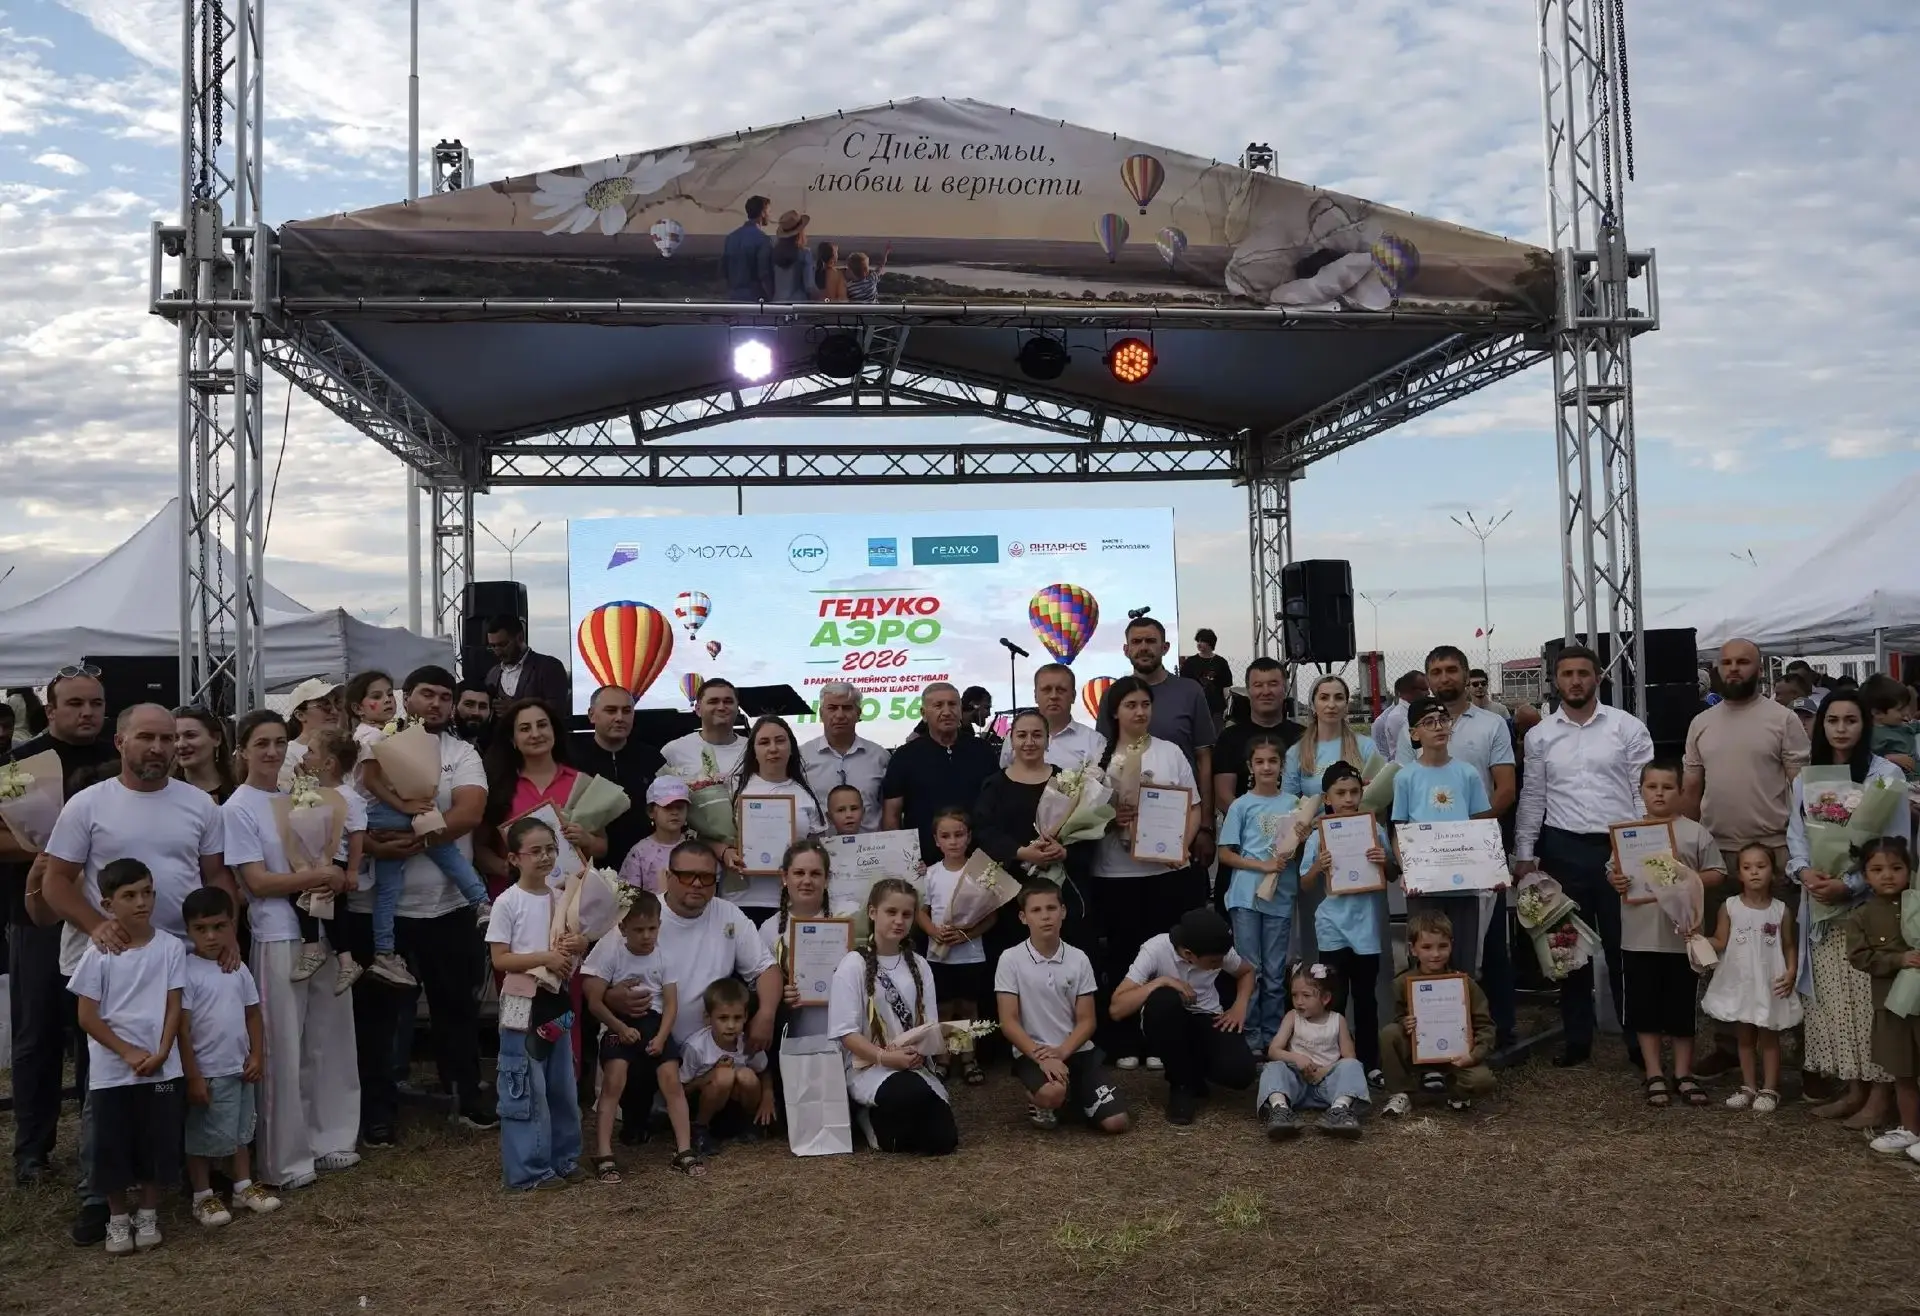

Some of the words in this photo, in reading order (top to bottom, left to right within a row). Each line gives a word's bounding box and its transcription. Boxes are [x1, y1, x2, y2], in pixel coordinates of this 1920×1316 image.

[843, 132, 865, 159] С
[868, 132, 951, 165] Днём
[961, 142, 1055, 166] семьи,
[808, 166, 903, 192] любви
[914, 175, 931, 193] и
[941, 175, 1083, 201] верности
[792, 548, 824, 559] КБР
[931, 545, 979, 555] ГЕДУКО
[1029, 542, 1087, 552] ЯНТАРНОЕ
[818, 596, 940, 620] ГЕДУКО
[809, 618, 941, 647] АЭРО
[841, 648, 909, 671] 2026
[846, 674, 897, 684] СЕМЕЙНОГО
[899, 673, 949, 682] ФЕСТИВАЛЯ
[889, 685, 920, 693] ШАРОВ
